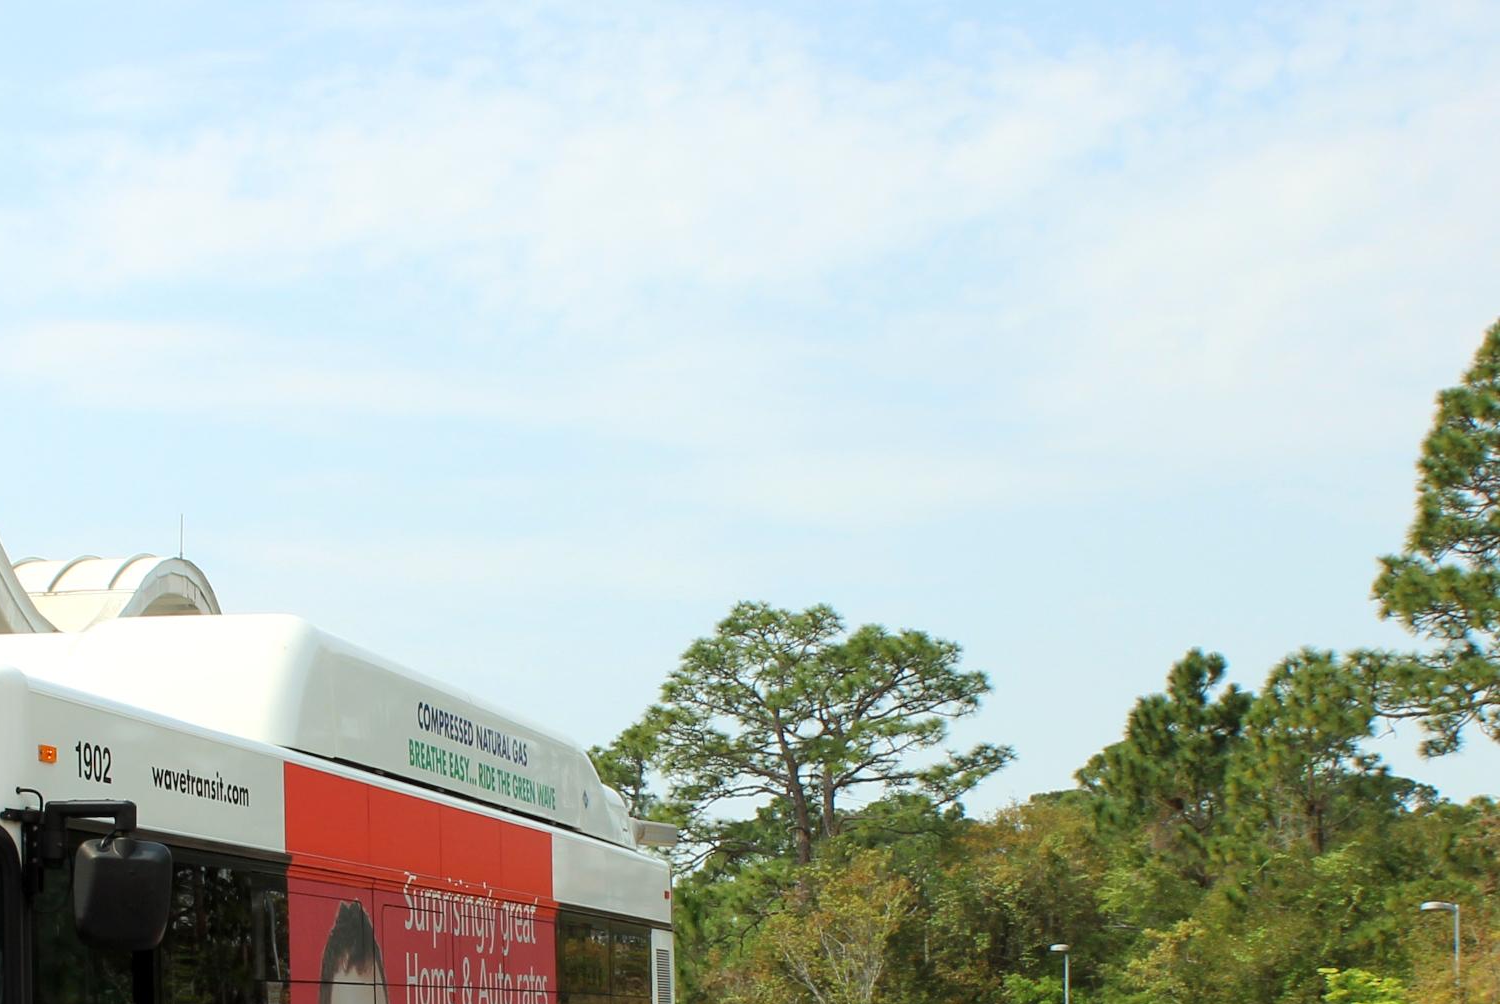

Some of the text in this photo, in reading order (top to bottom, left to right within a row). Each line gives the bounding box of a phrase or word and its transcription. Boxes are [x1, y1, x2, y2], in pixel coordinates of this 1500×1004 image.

[75, 741, 112, 784] 1902
[417, 701, 528, 767] COMPRESSED NATURAL GAS
[151, 767, 250, 807] wavetransit.com
[409, 739, 447, 776] BREATHE
[478, 763, 496, 792] RIDE
[498, 769, 511, 797] THE
[512, 774, 536, 804] GREEN
[537, 783, 556, 810] WAVE
[404, 871, 539, 956] Surprisingly great
